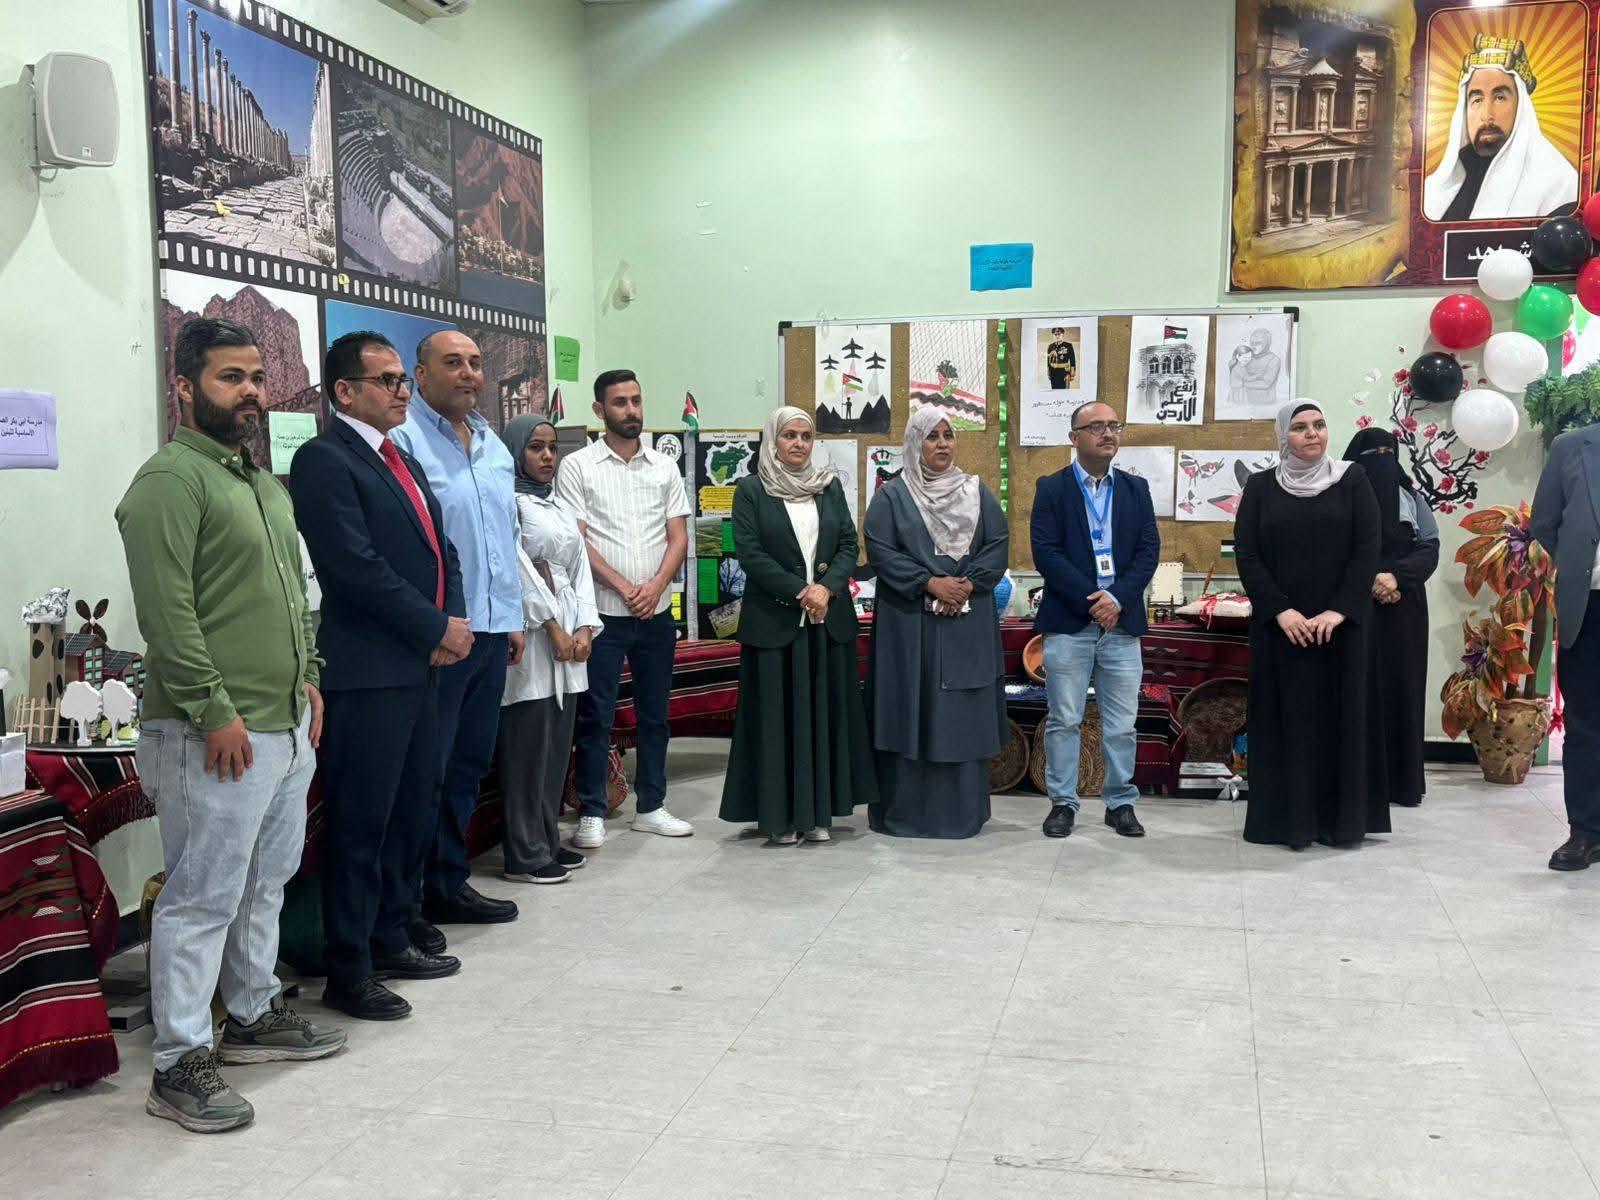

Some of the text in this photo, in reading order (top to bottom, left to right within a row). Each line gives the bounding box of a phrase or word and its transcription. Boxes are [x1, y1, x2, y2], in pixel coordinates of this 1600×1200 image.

[1161, 391, 1184, 409] علم
[1156, 397, 1197, 422] الأردن
[10, 417, 18, 426] بكر
[26, 416, 42, 427] مدرسة
